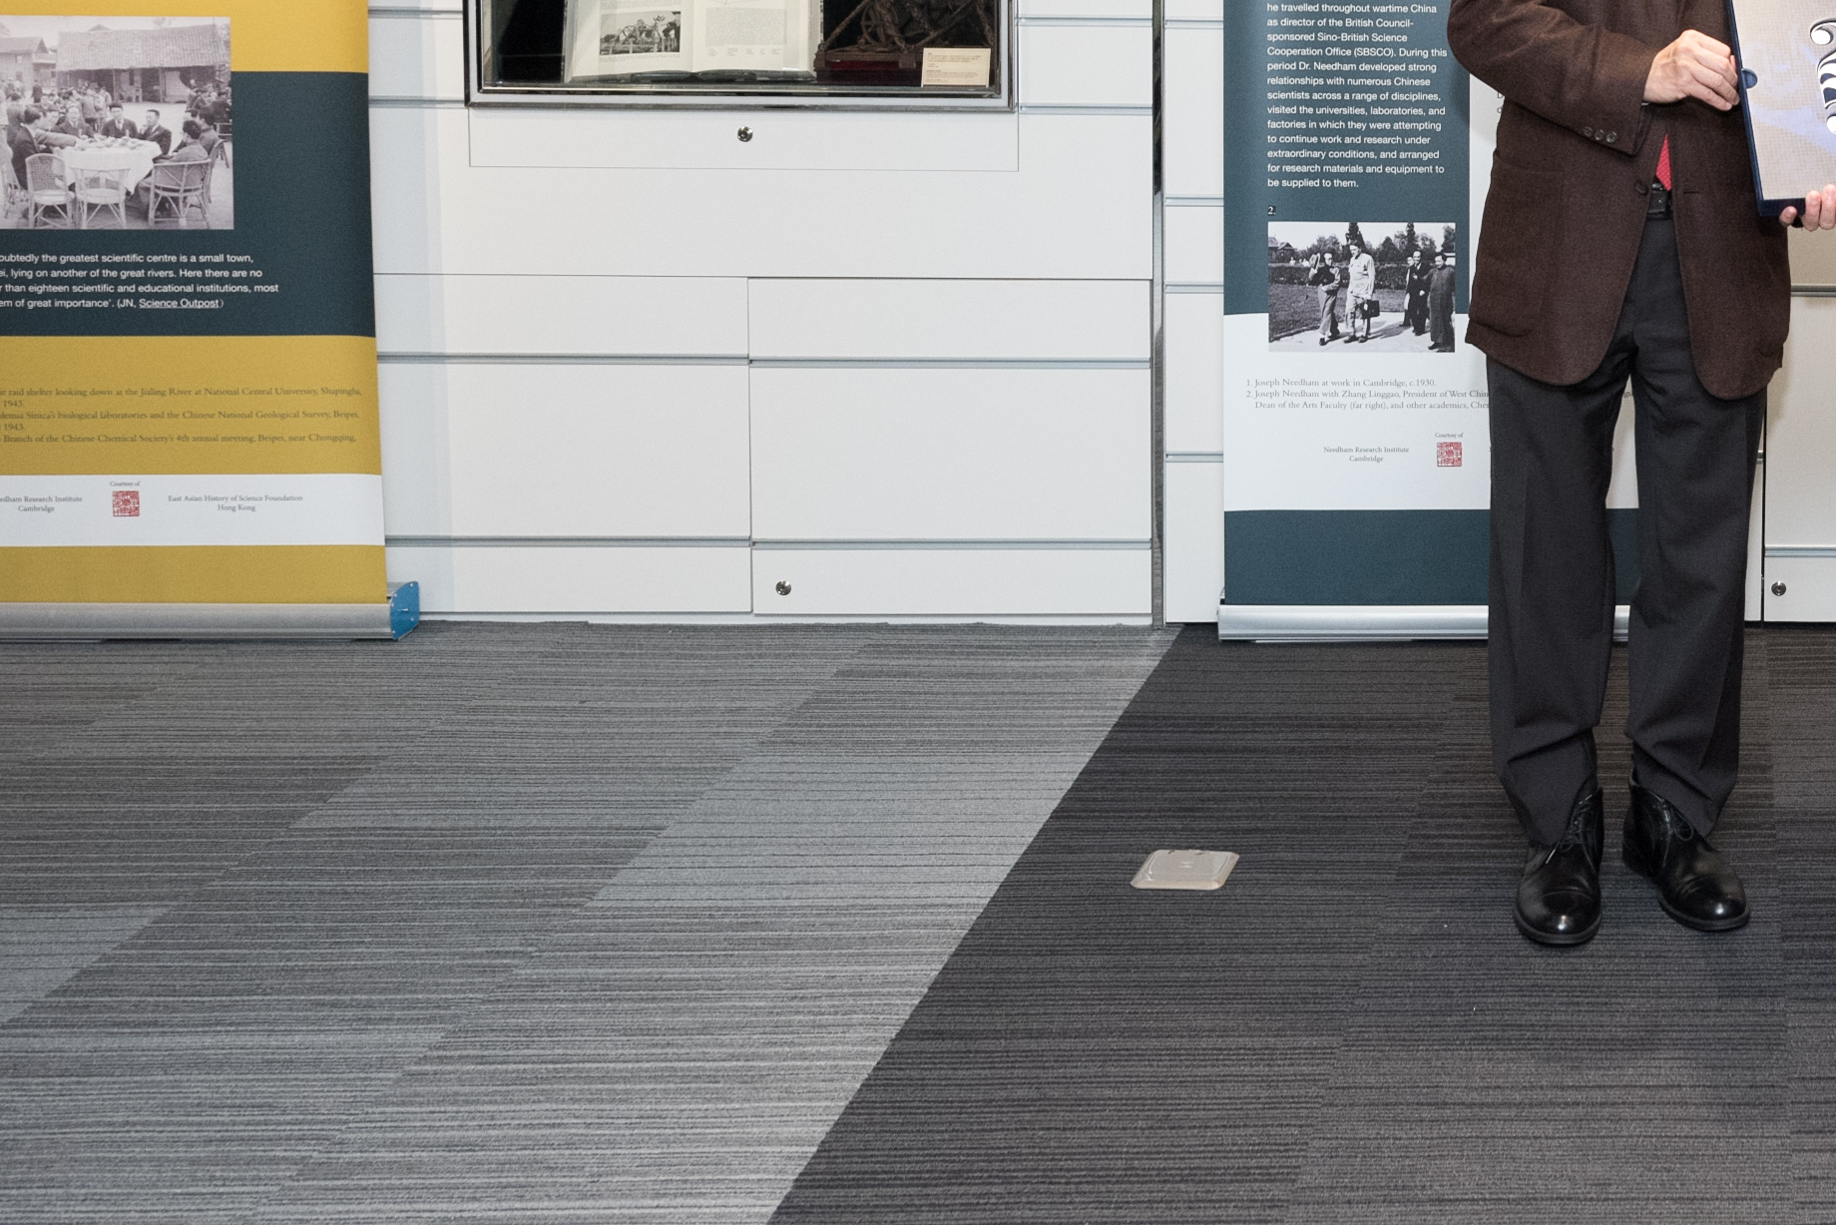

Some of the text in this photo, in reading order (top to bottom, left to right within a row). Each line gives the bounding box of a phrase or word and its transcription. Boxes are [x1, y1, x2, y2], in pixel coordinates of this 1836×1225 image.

[1267, 3, 1437, 14] he travelled throughout wartime China
[1267, 32, 1407, 42] sponsored Sino-British Science
[1267, 47, 1447, 58] Cooperation Office (SBSCO). During this
[1267, 62, 1436, 73] period Dr. Needham developed strong
[1267, 76, 1324, 86] relationships
[1326, 77, 1344, 85] with
[1394, 77, 1430, 86] Chinese
[42, 254, 57, 262] the
[59, 254, 98, 264] greatest
[101, 254, 144, 262] scientific
[146, 254, 177, 262] centre
[180, 254, 188, 262] is
[199, 254, 224, 262] small
[226, 254, 253, 263] town,
[15, 298, 224, 309] of great importance'. (JN, Science Outpost)
[1349, 455, 1383, 463] Cambridge
[204, 495, 228, 503] History
[18, 505, 54, 513] Cambridge
[218, 504, 256, 512] Hong Kong
